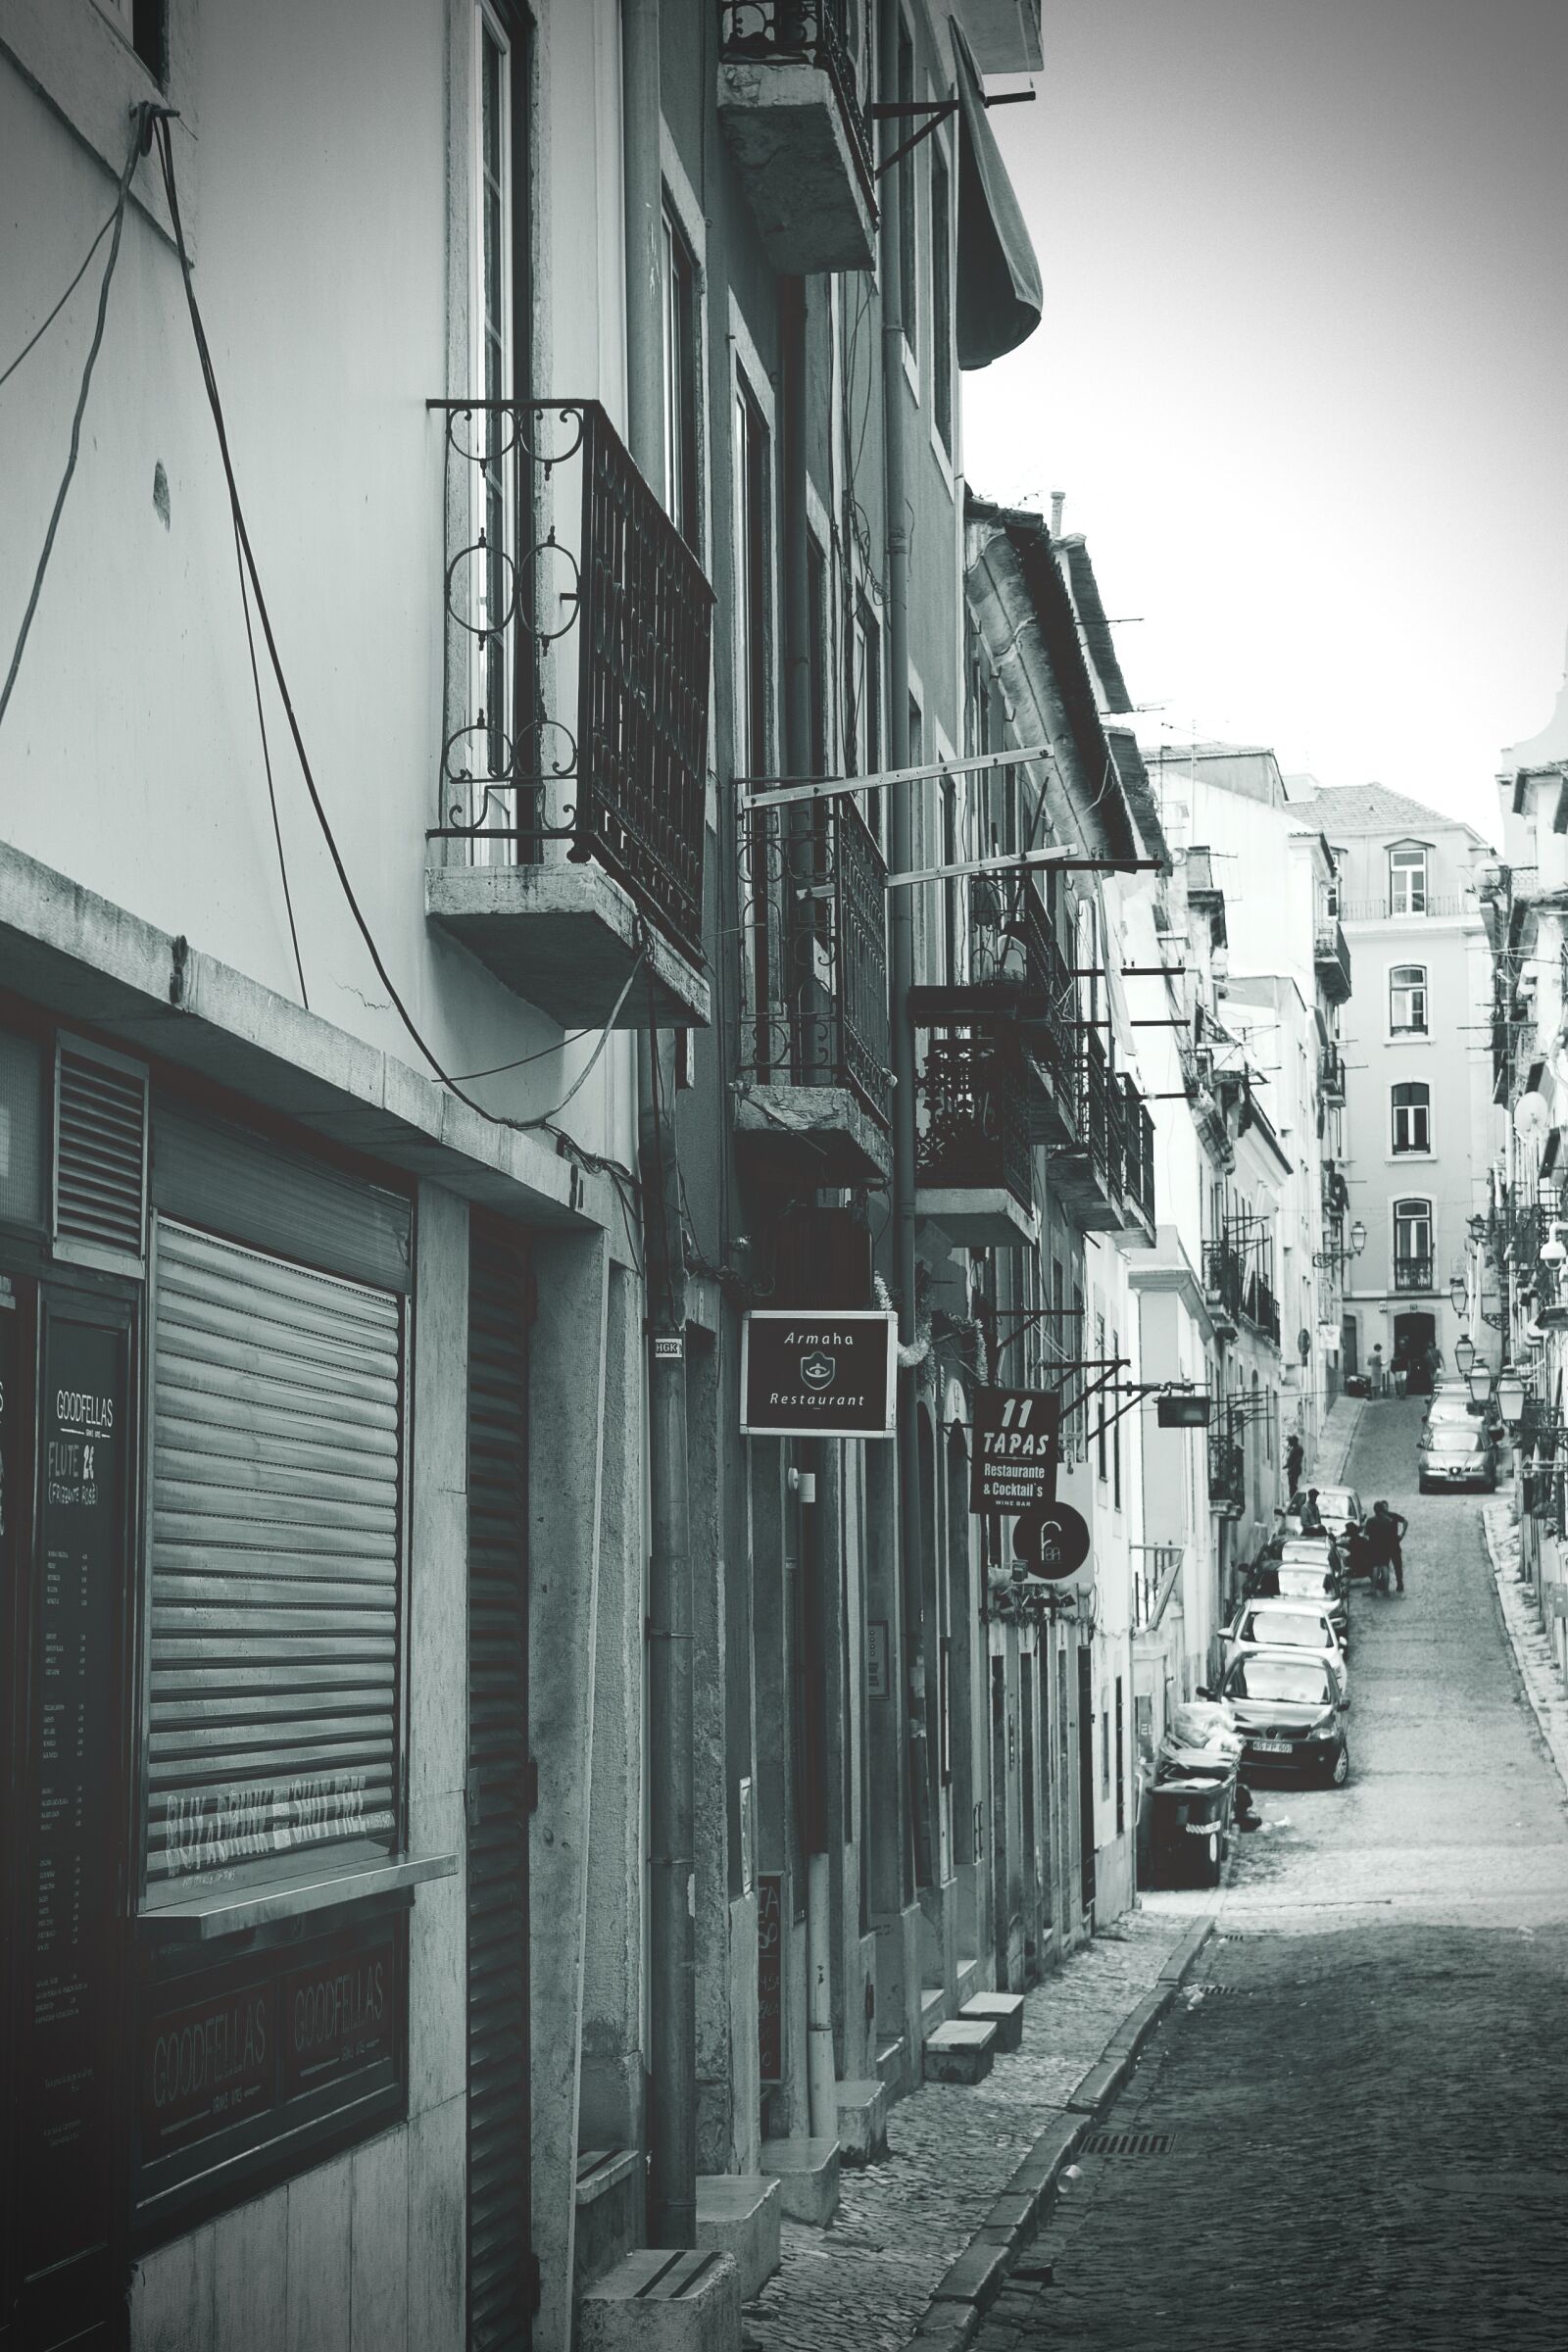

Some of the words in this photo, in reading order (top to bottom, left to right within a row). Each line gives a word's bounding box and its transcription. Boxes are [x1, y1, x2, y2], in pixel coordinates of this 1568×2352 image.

[784, 1332, 854, 1346] Armaha
[56, 1390, 113, 1428] GOODFELLAS
[769, 1393, 864, 1406] Restaurant
[1001, 1398, 1033, 1428] 11
[983, 1432, 1050, 1455] TAPAS
[49, 1442, 79, 1478] FLUTE
[984, 1463, 1045, 1479] Restaurante
[983, 1483, 991, 1495] &
[294, 1961, 383, 2053] GOODFELLAS
[154, 1998, 266, 2108] GOODFELLAS
